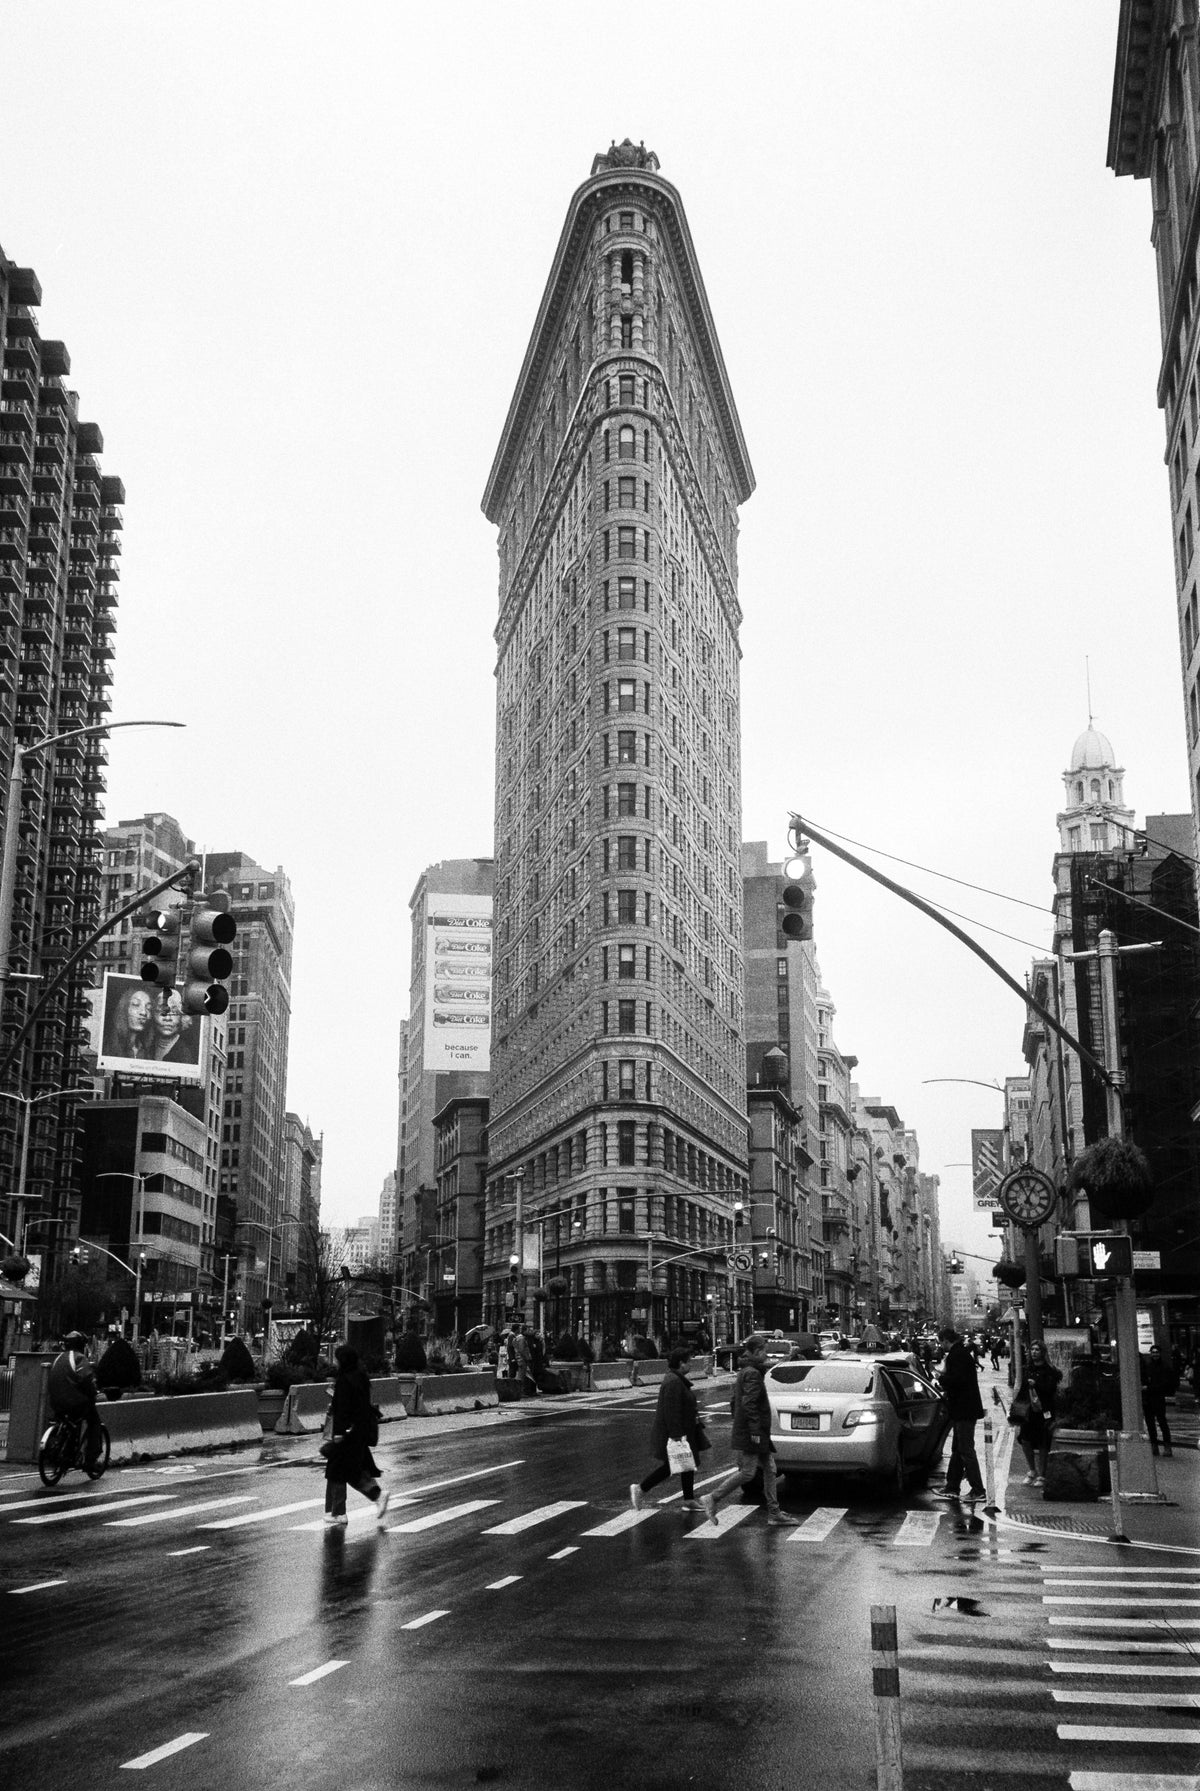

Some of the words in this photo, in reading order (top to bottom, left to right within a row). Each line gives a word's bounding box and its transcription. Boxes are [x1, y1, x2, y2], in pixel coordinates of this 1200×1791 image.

[447, 918, 465, 926] Diet
[466, 918, 490, 928] Coke
[465, 943, 487, 952] Coke
[465, 967, 487, 975] Coke
[464, 990, 486, 1000] Coke
[463, 1015, 486, 1024] Coke
